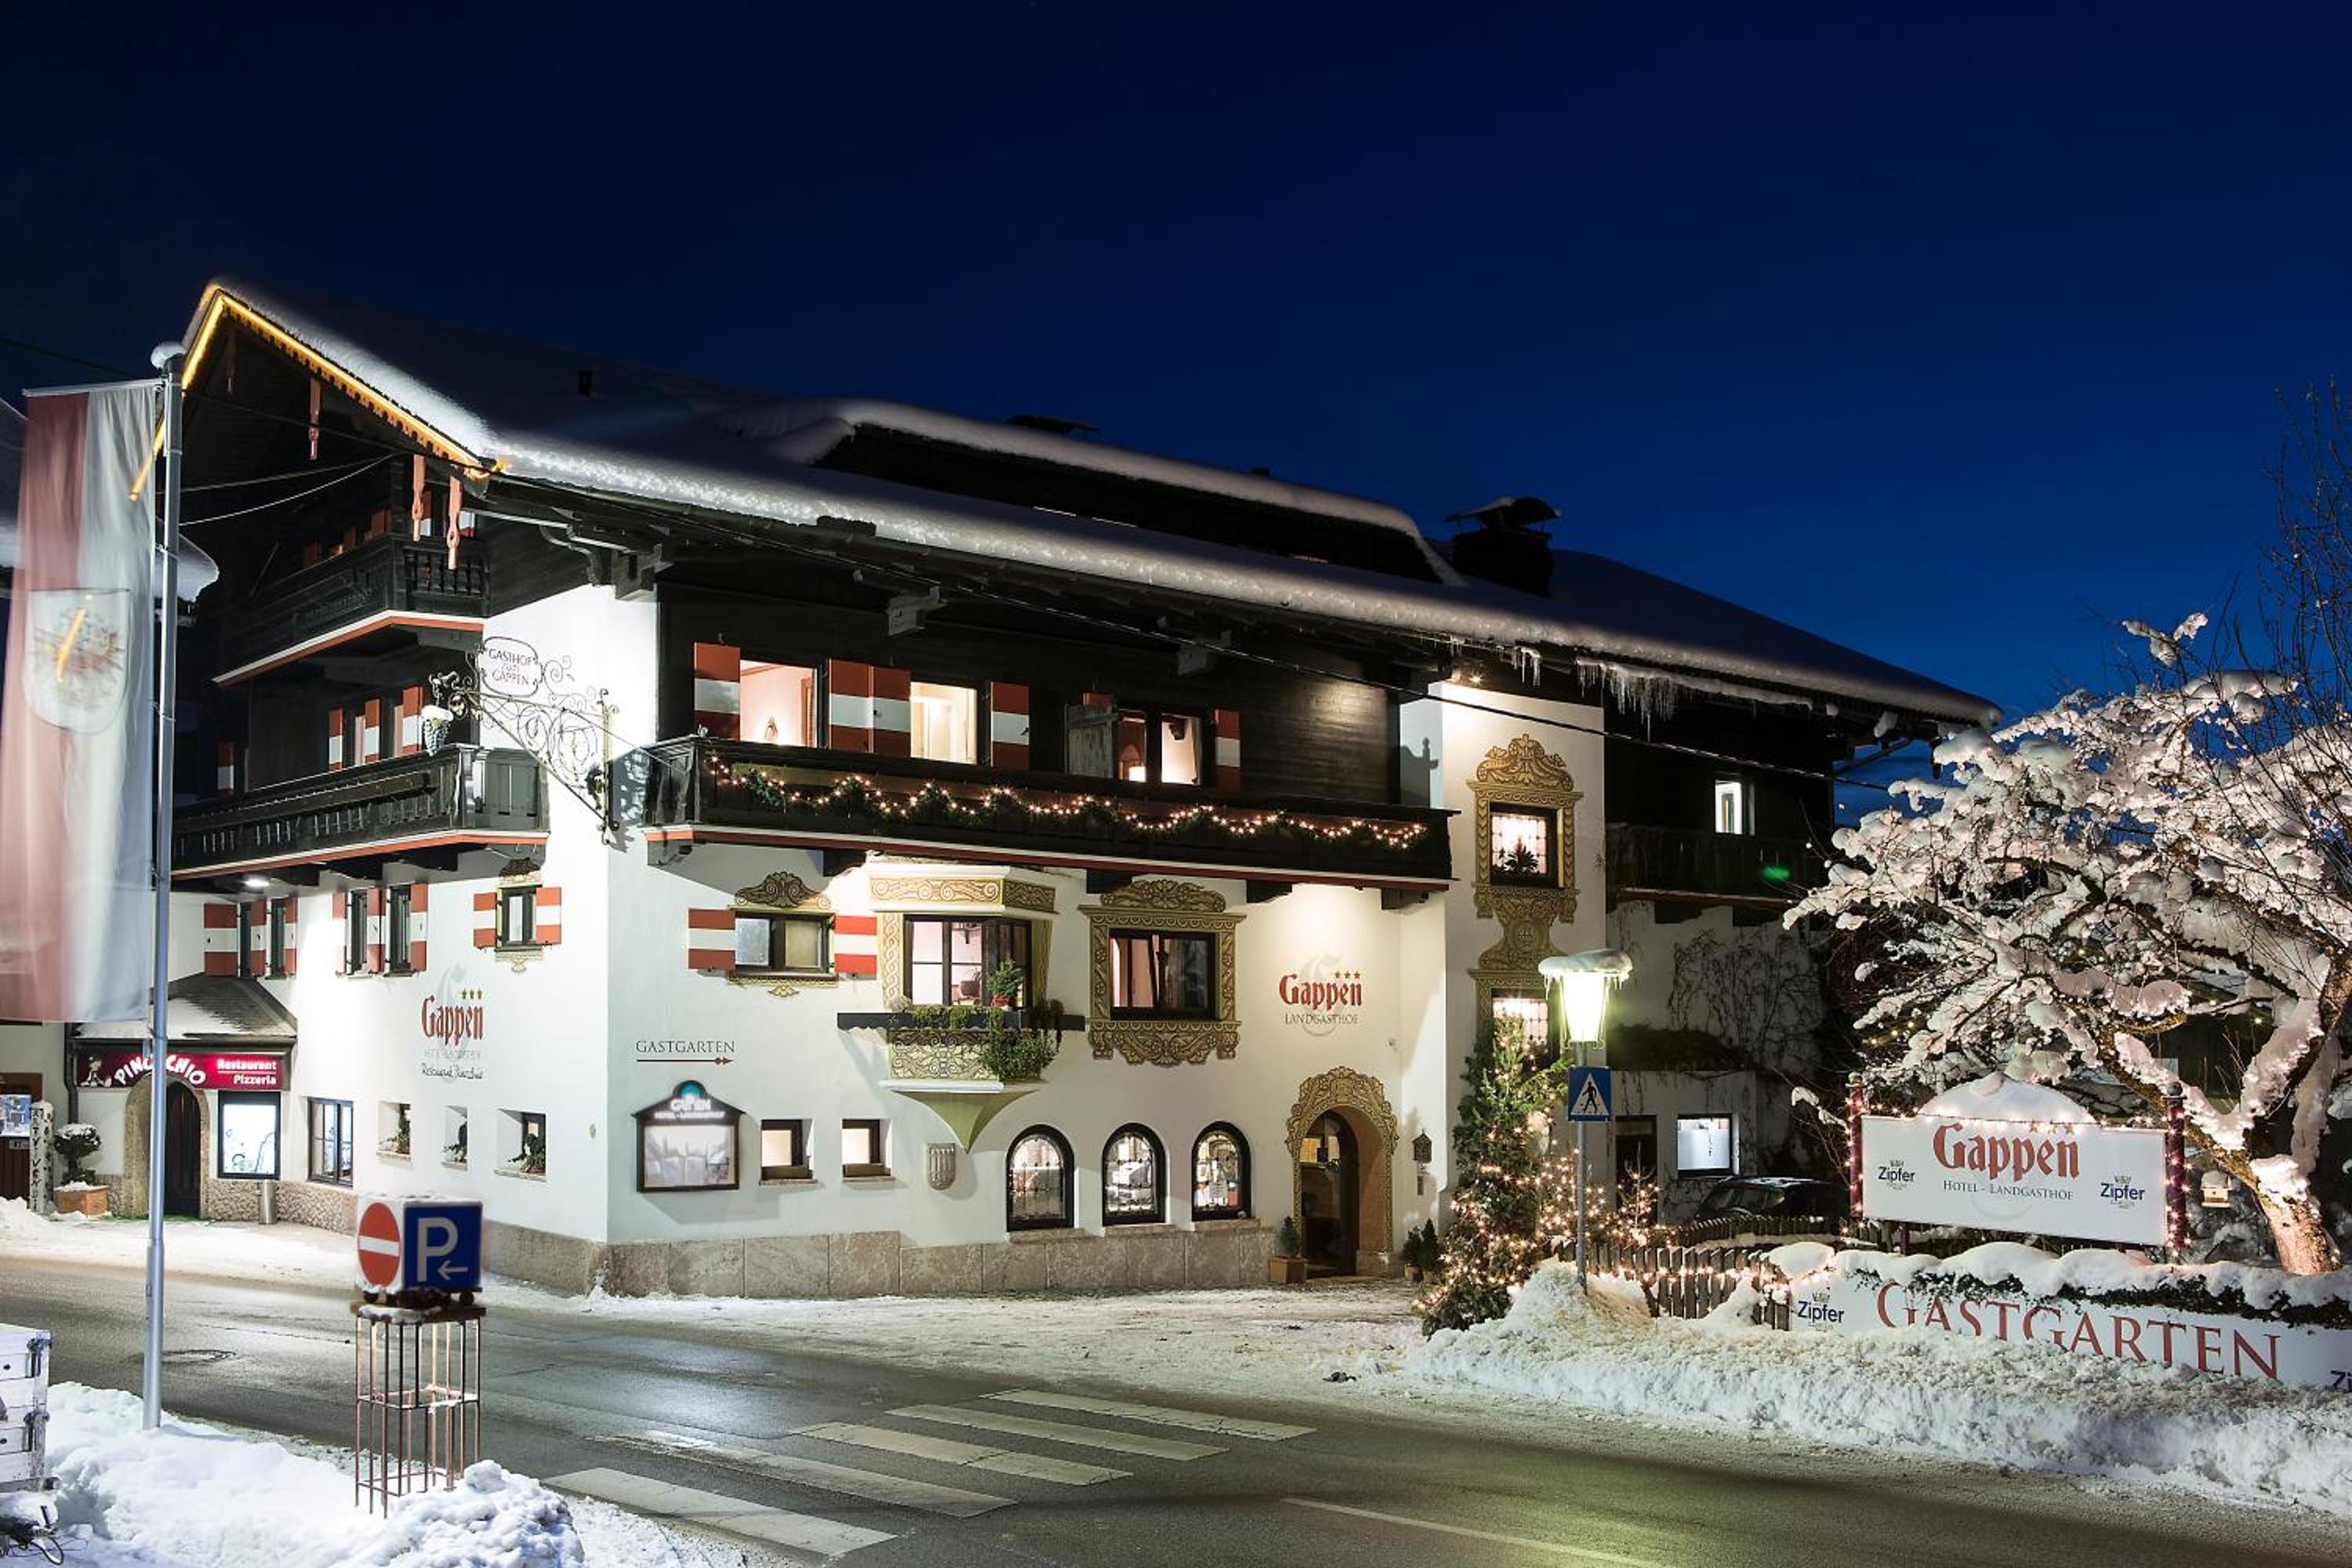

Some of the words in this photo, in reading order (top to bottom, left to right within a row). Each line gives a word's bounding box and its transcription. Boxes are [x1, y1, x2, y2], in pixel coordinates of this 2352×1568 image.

[1279, 973, 1362, 1011] Gappen
[422, 995, 484, 1046] Gappen
[636, 1040, 735, 1053] GASTGARTEN
[114, 1054, 206, 1085] PINOCHIO
[217, 1058, 277, 1070] Restaurant
[233, 1074, 277, 1085] Pizzeria
[1933, 1123, 2080, 1182] Gappen
[1878, 1166, 1915, 1183] Zipfer
[2100, 1182, 2145, 1201] Zipfer
[417, 1217, 459, 1282] P
[1798, 1301, 1845, 1323] Zipfer
[1877, 1279, 2281, 1380] GASTGARTEN
